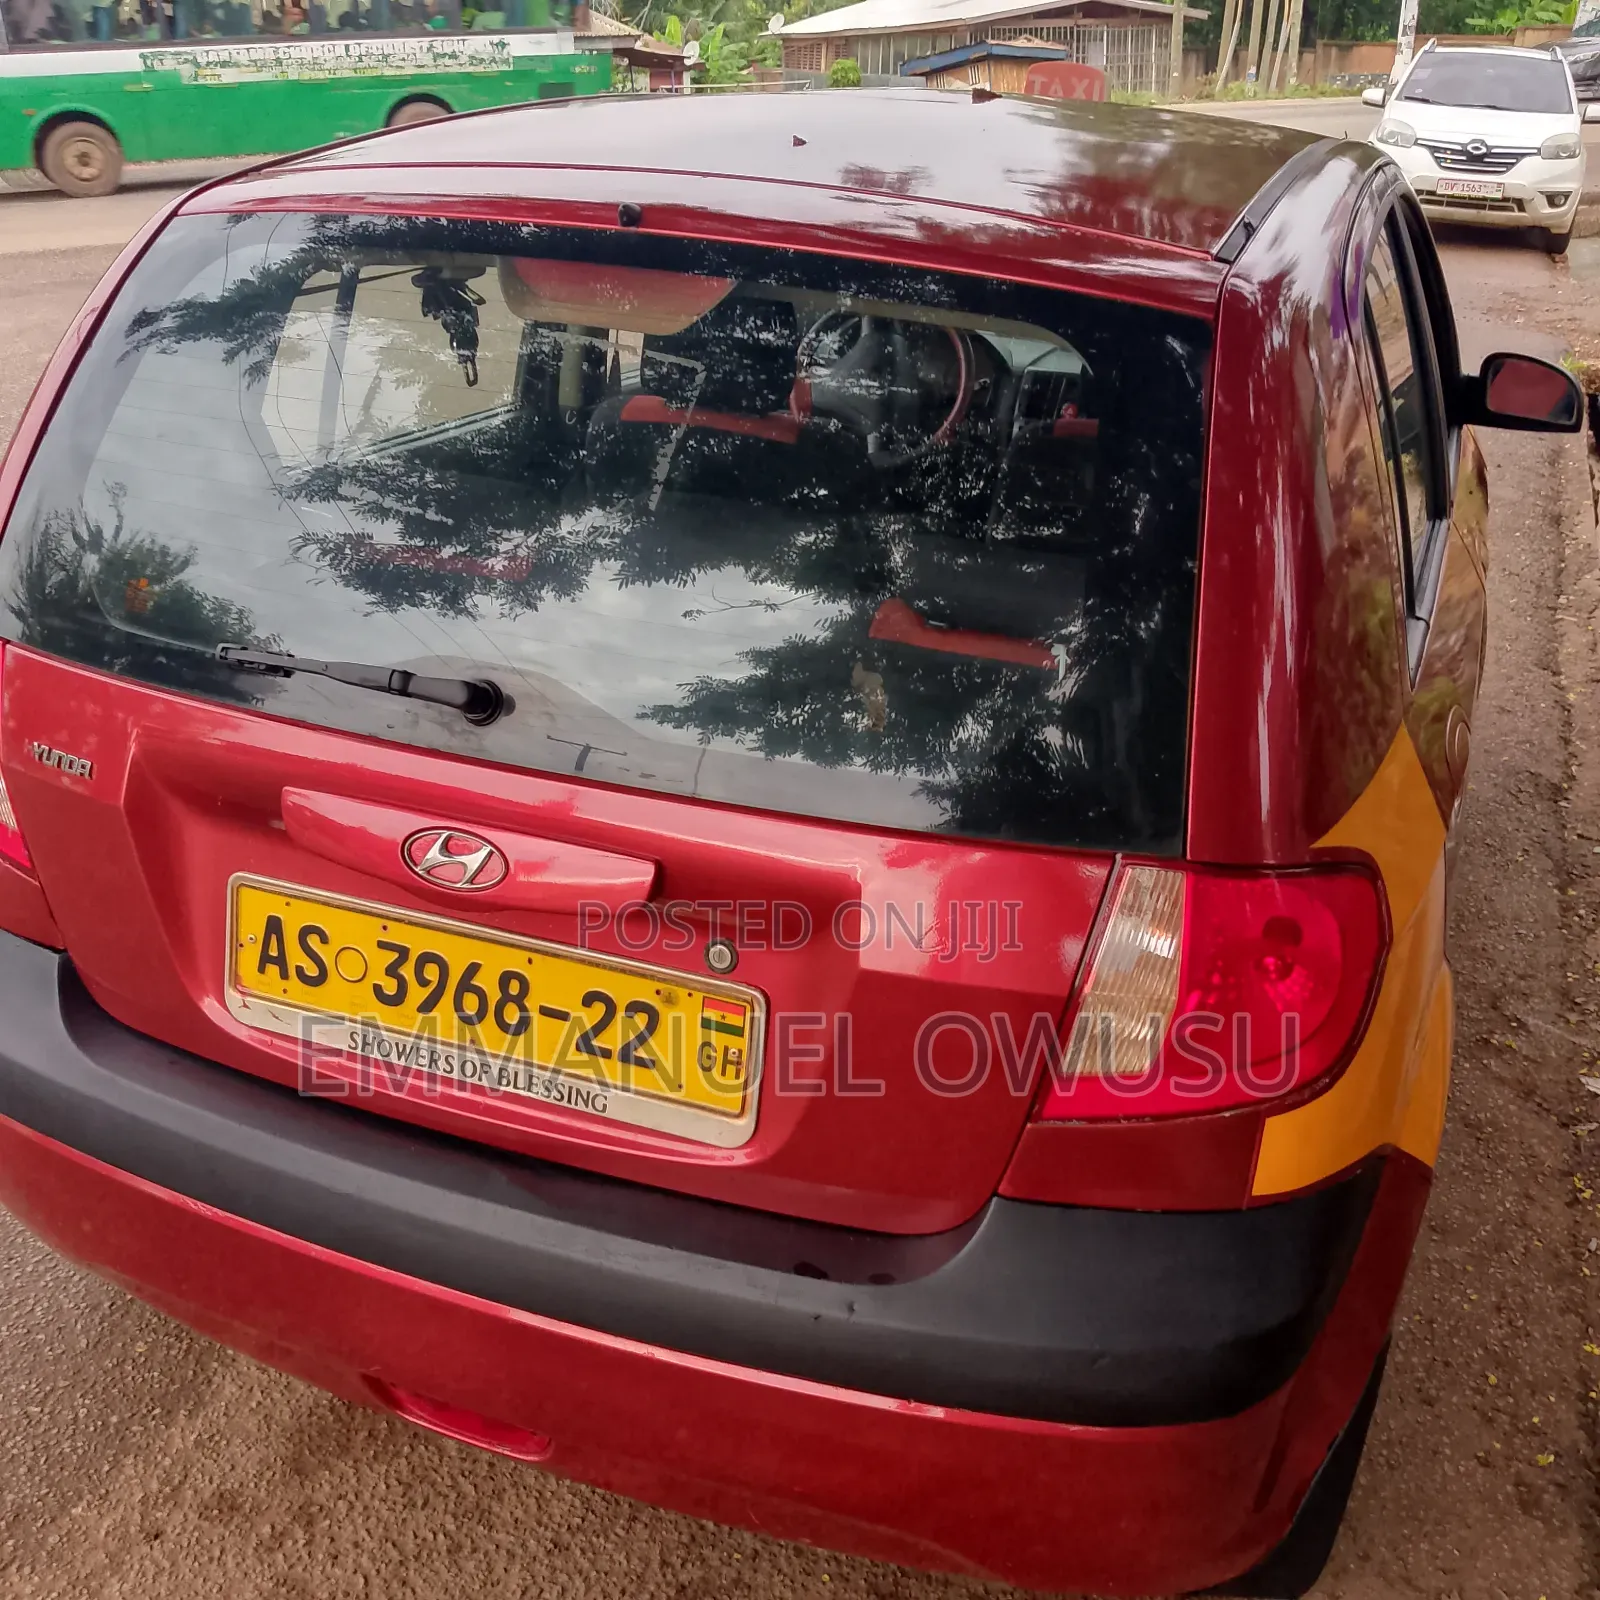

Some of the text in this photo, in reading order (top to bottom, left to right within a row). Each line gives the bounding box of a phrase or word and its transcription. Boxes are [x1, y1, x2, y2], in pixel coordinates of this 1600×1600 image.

[1029, 74, 1101, 101] TAXI
[1444, 182, 1457, 191] DV
[1460, 183, 1483, 193] 1563
[257, 914, 660, 1070] AS 3968-22
[348, 1031, 608, 1114] SHOWERS OF BLESSING
[697, 1041, 743, 1080] GH
